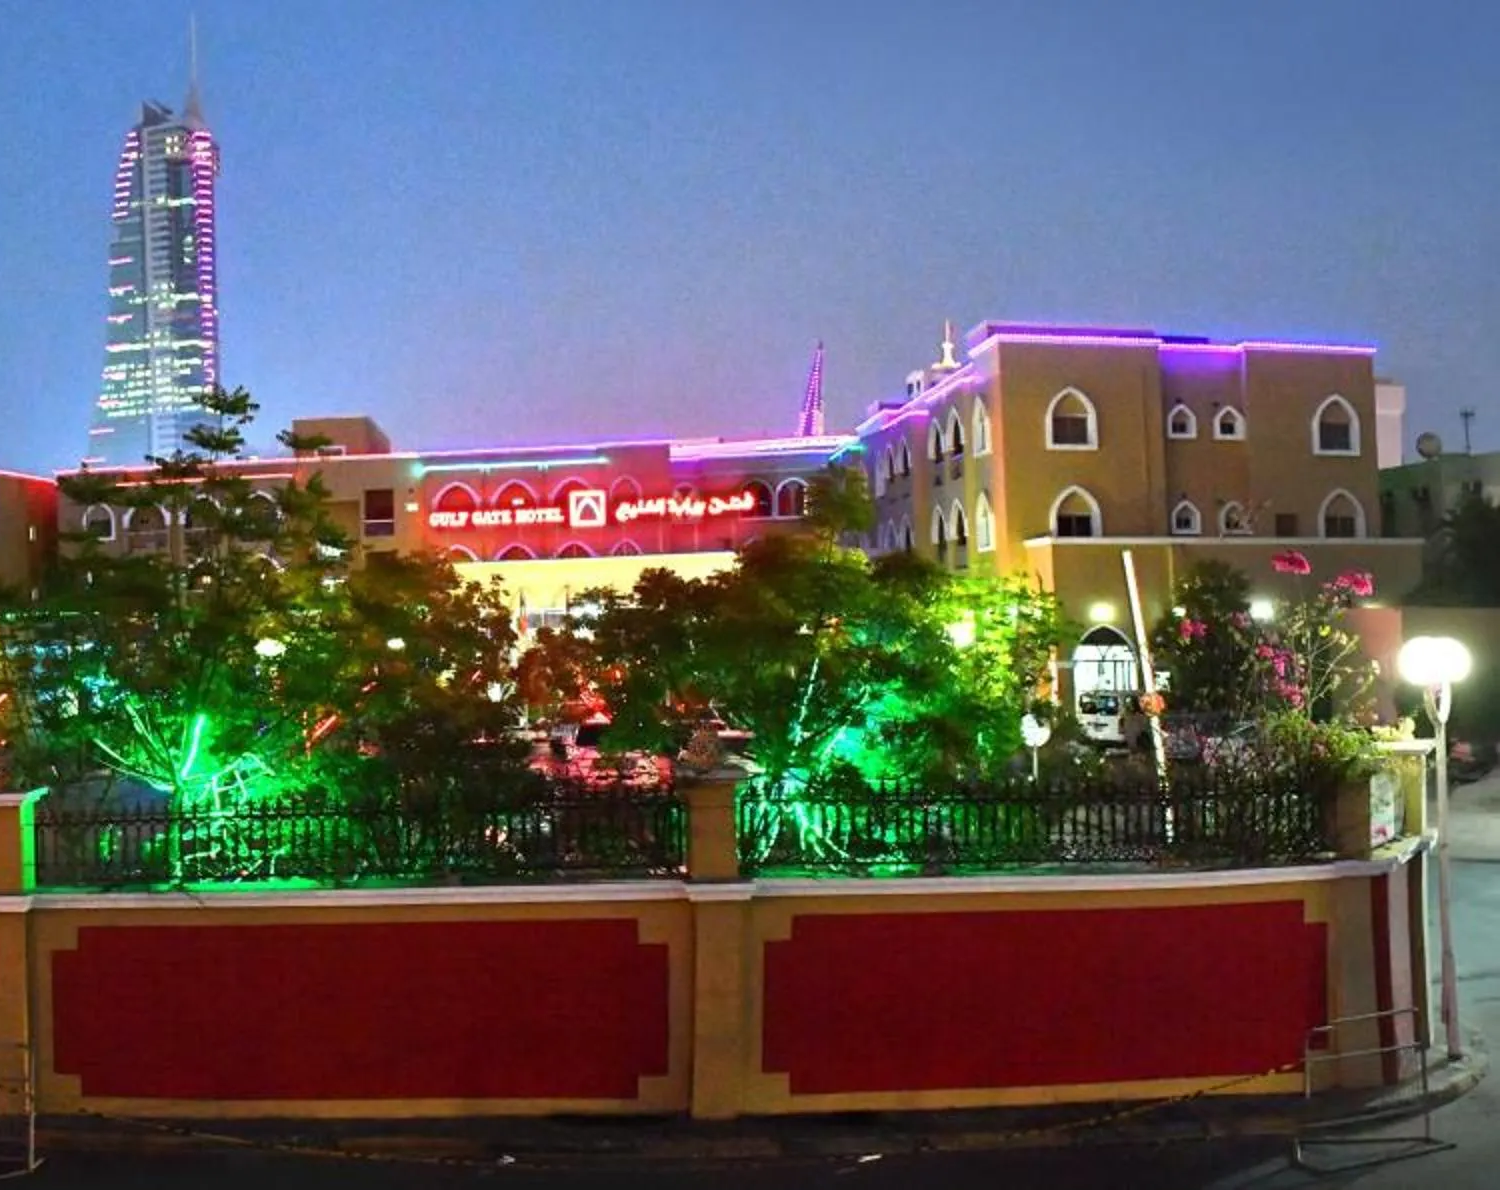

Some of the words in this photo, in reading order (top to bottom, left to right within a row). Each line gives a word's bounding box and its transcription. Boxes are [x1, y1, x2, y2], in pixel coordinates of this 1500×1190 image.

[429, 511, 469, 528] GULF
[471, 509, 513, 526] GATE
[515, 507, 565, 525] HOTEL
